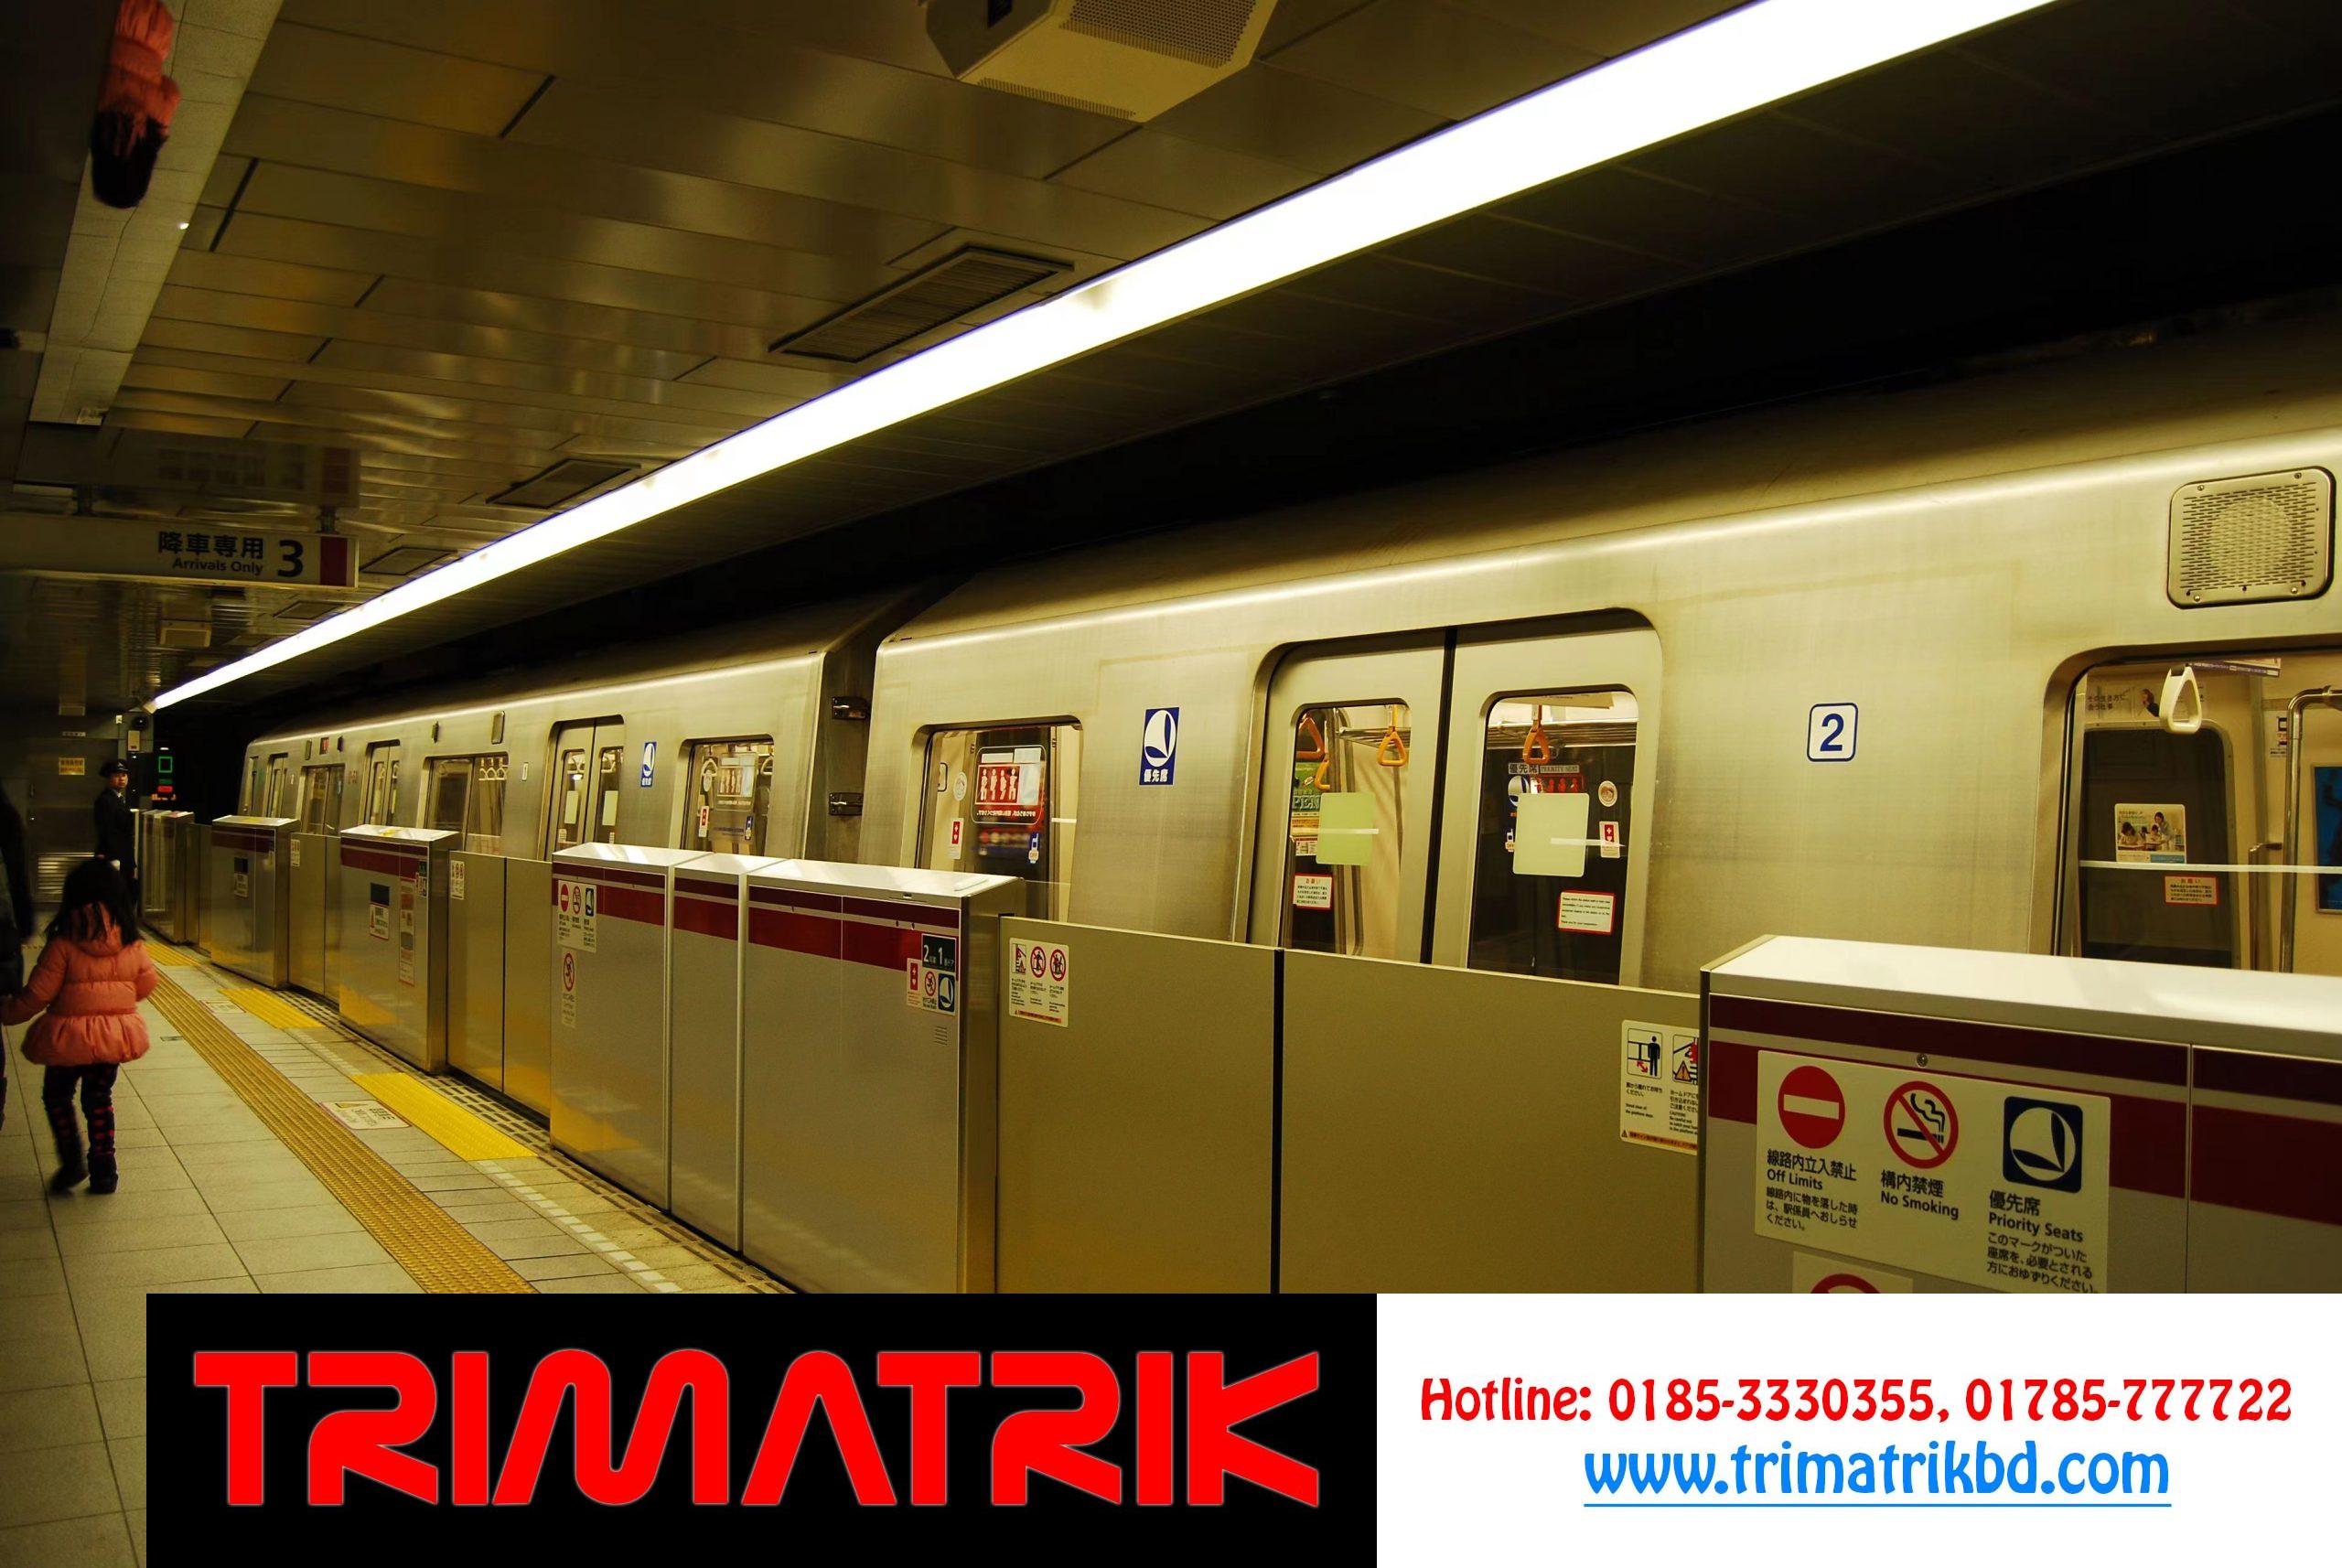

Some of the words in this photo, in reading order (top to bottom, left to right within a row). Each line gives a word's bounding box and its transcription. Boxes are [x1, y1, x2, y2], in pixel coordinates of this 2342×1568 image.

[158, 531, 263, 560] 降車専用
[277, 539, 304, 577] 3
[172, 557, 227, 572] Arrivals
[231, 561, 263, 576] Only
[1820, 714, 1844, 751] 2
[924, 944, 929, 962] 2
[938, 947, 943, 965] 1
[1767, 1148, 1857, 1181] 線路内立入禁止
[1767, 1168, 1786, 1183] Off
[1789, 1172, 1823, 1190] Limits
[1881, 1169, 1944, 1197] 構内禁煙
[1881, 1190, 1898, 1206] No
[1902, 1195, 1959, 1220] Smoking
[1989, 1189, 2041, 1217] 優先席
[1767, 1213, 1805, 1230] ください。
[1989, 1211, 2040, 1237] Priority
[2045, 1222, 2084, 1243] Seats
[1988, 1231, 2088, 1263] このマークがついた
